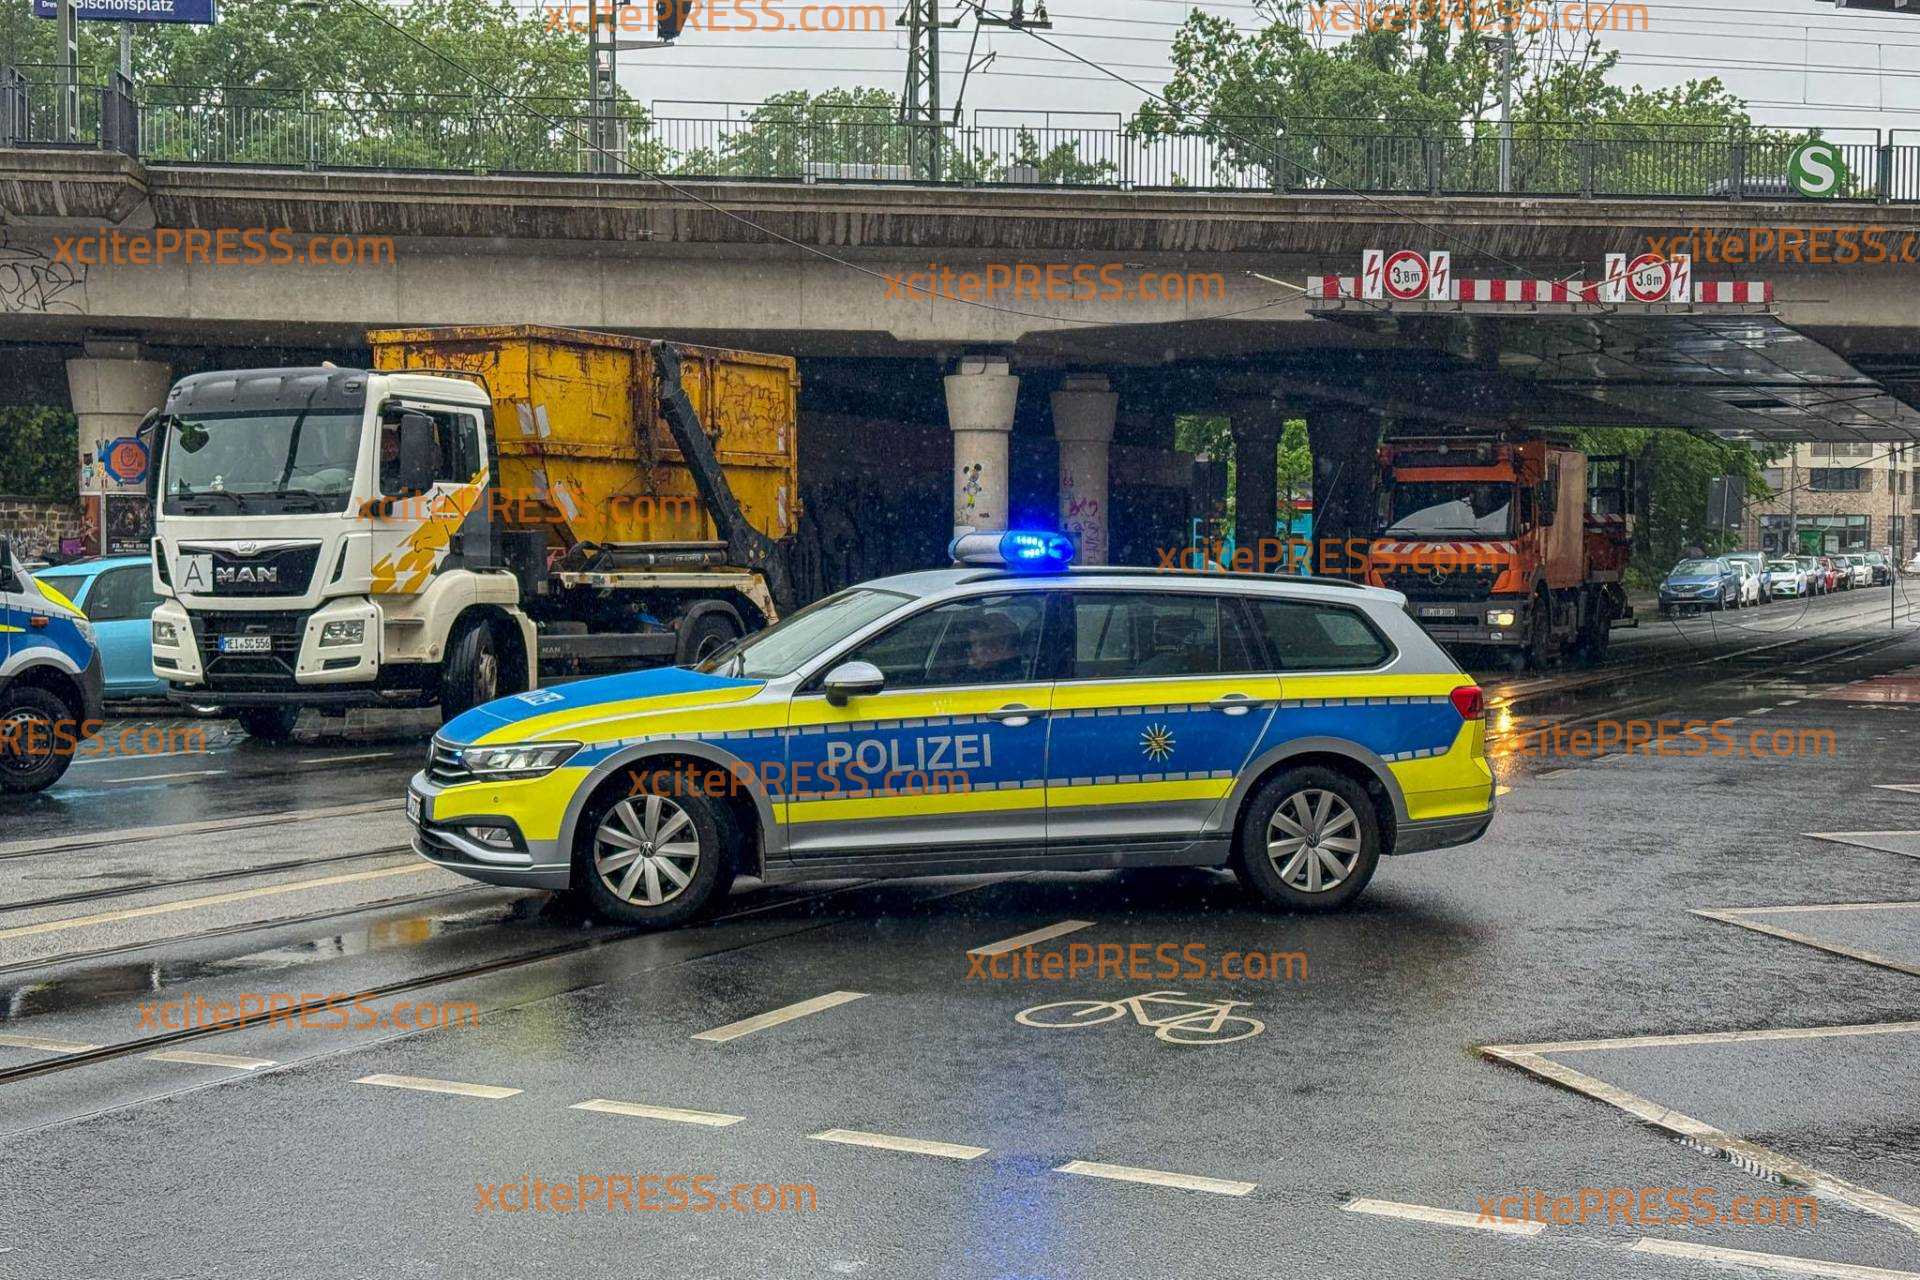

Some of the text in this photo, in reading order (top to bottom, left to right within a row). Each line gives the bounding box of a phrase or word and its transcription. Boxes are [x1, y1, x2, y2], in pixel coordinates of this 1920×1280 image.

[1800, 146, 1835, 193] S
[216, 567, 277, 583] MAN
[827, 734, 991, 776] POLIZEI
